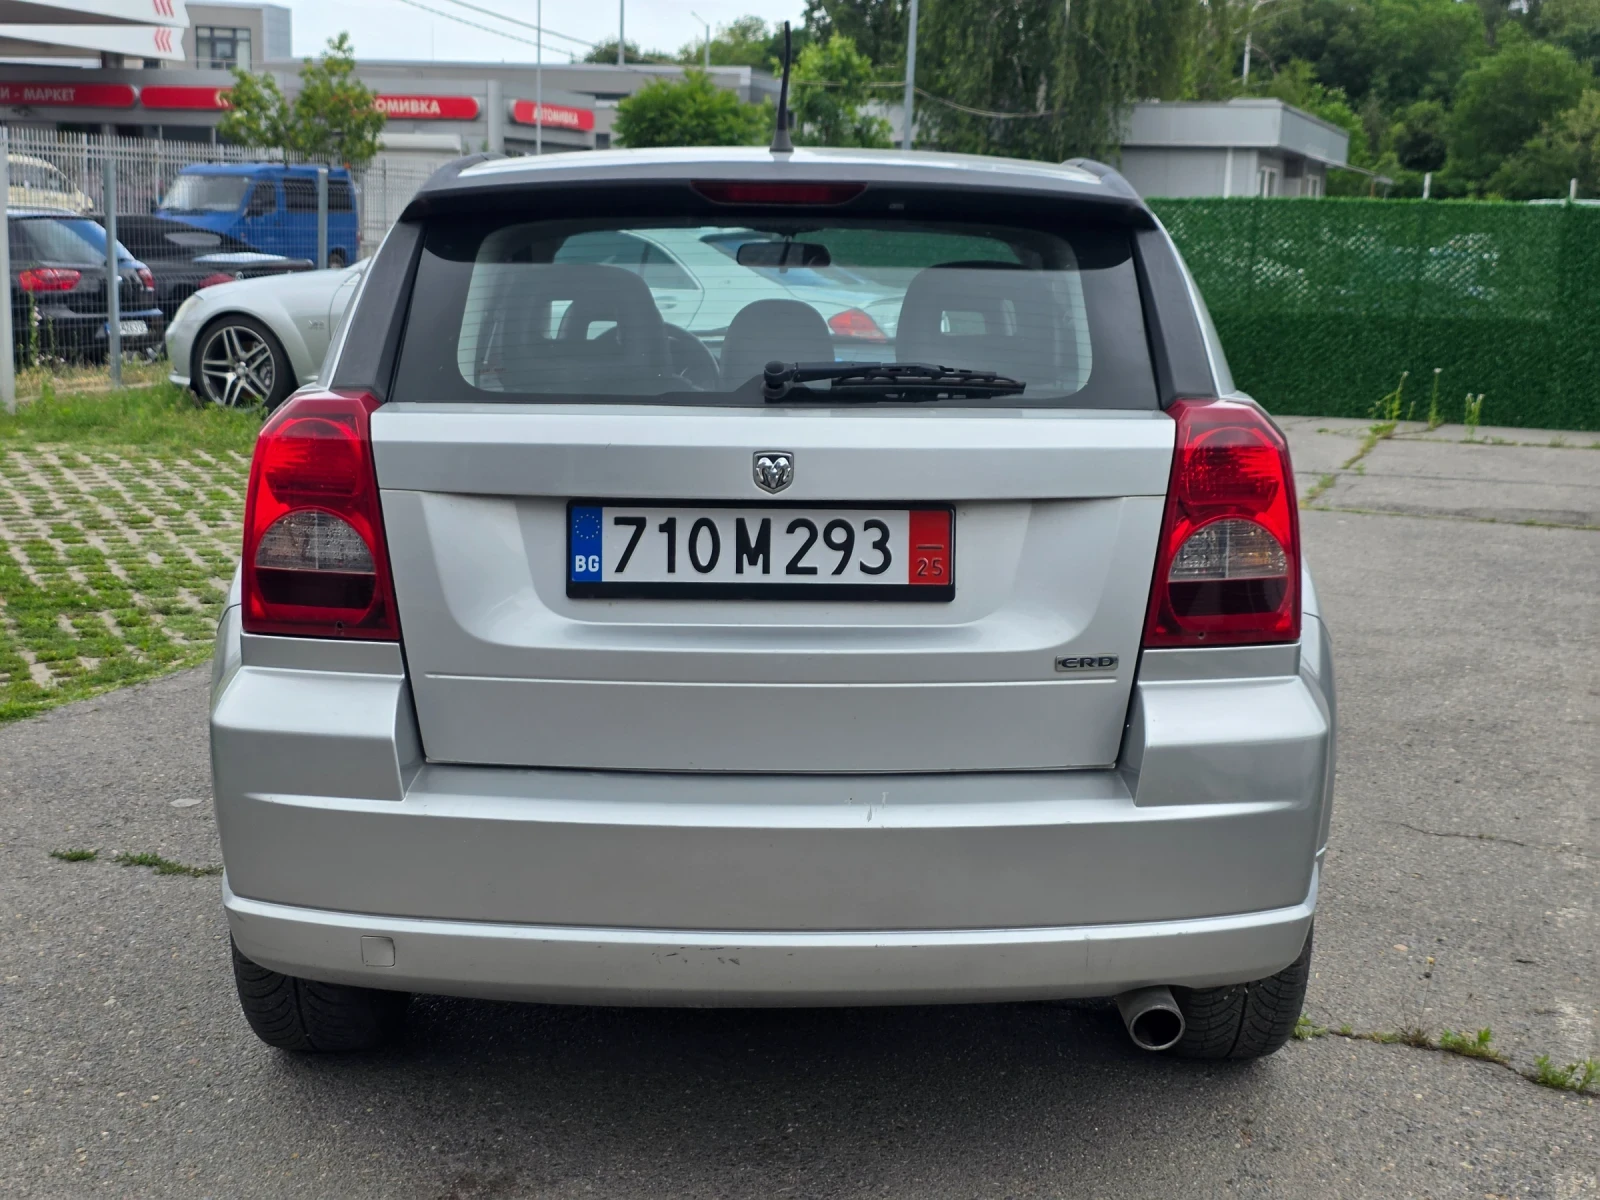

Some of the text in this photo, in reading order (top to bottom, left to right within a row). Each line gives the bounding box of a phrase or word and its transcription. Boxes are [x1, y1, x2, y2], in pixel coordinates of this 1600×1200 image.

[23, 87, 76, 101] МАРКЕТ
[375, 97, 441, 114] ОМИВКА
[575, 555, 600, 573] BG
[916, 557, 944, 577] 25
[1060, 656, 1115, 669] CRD
